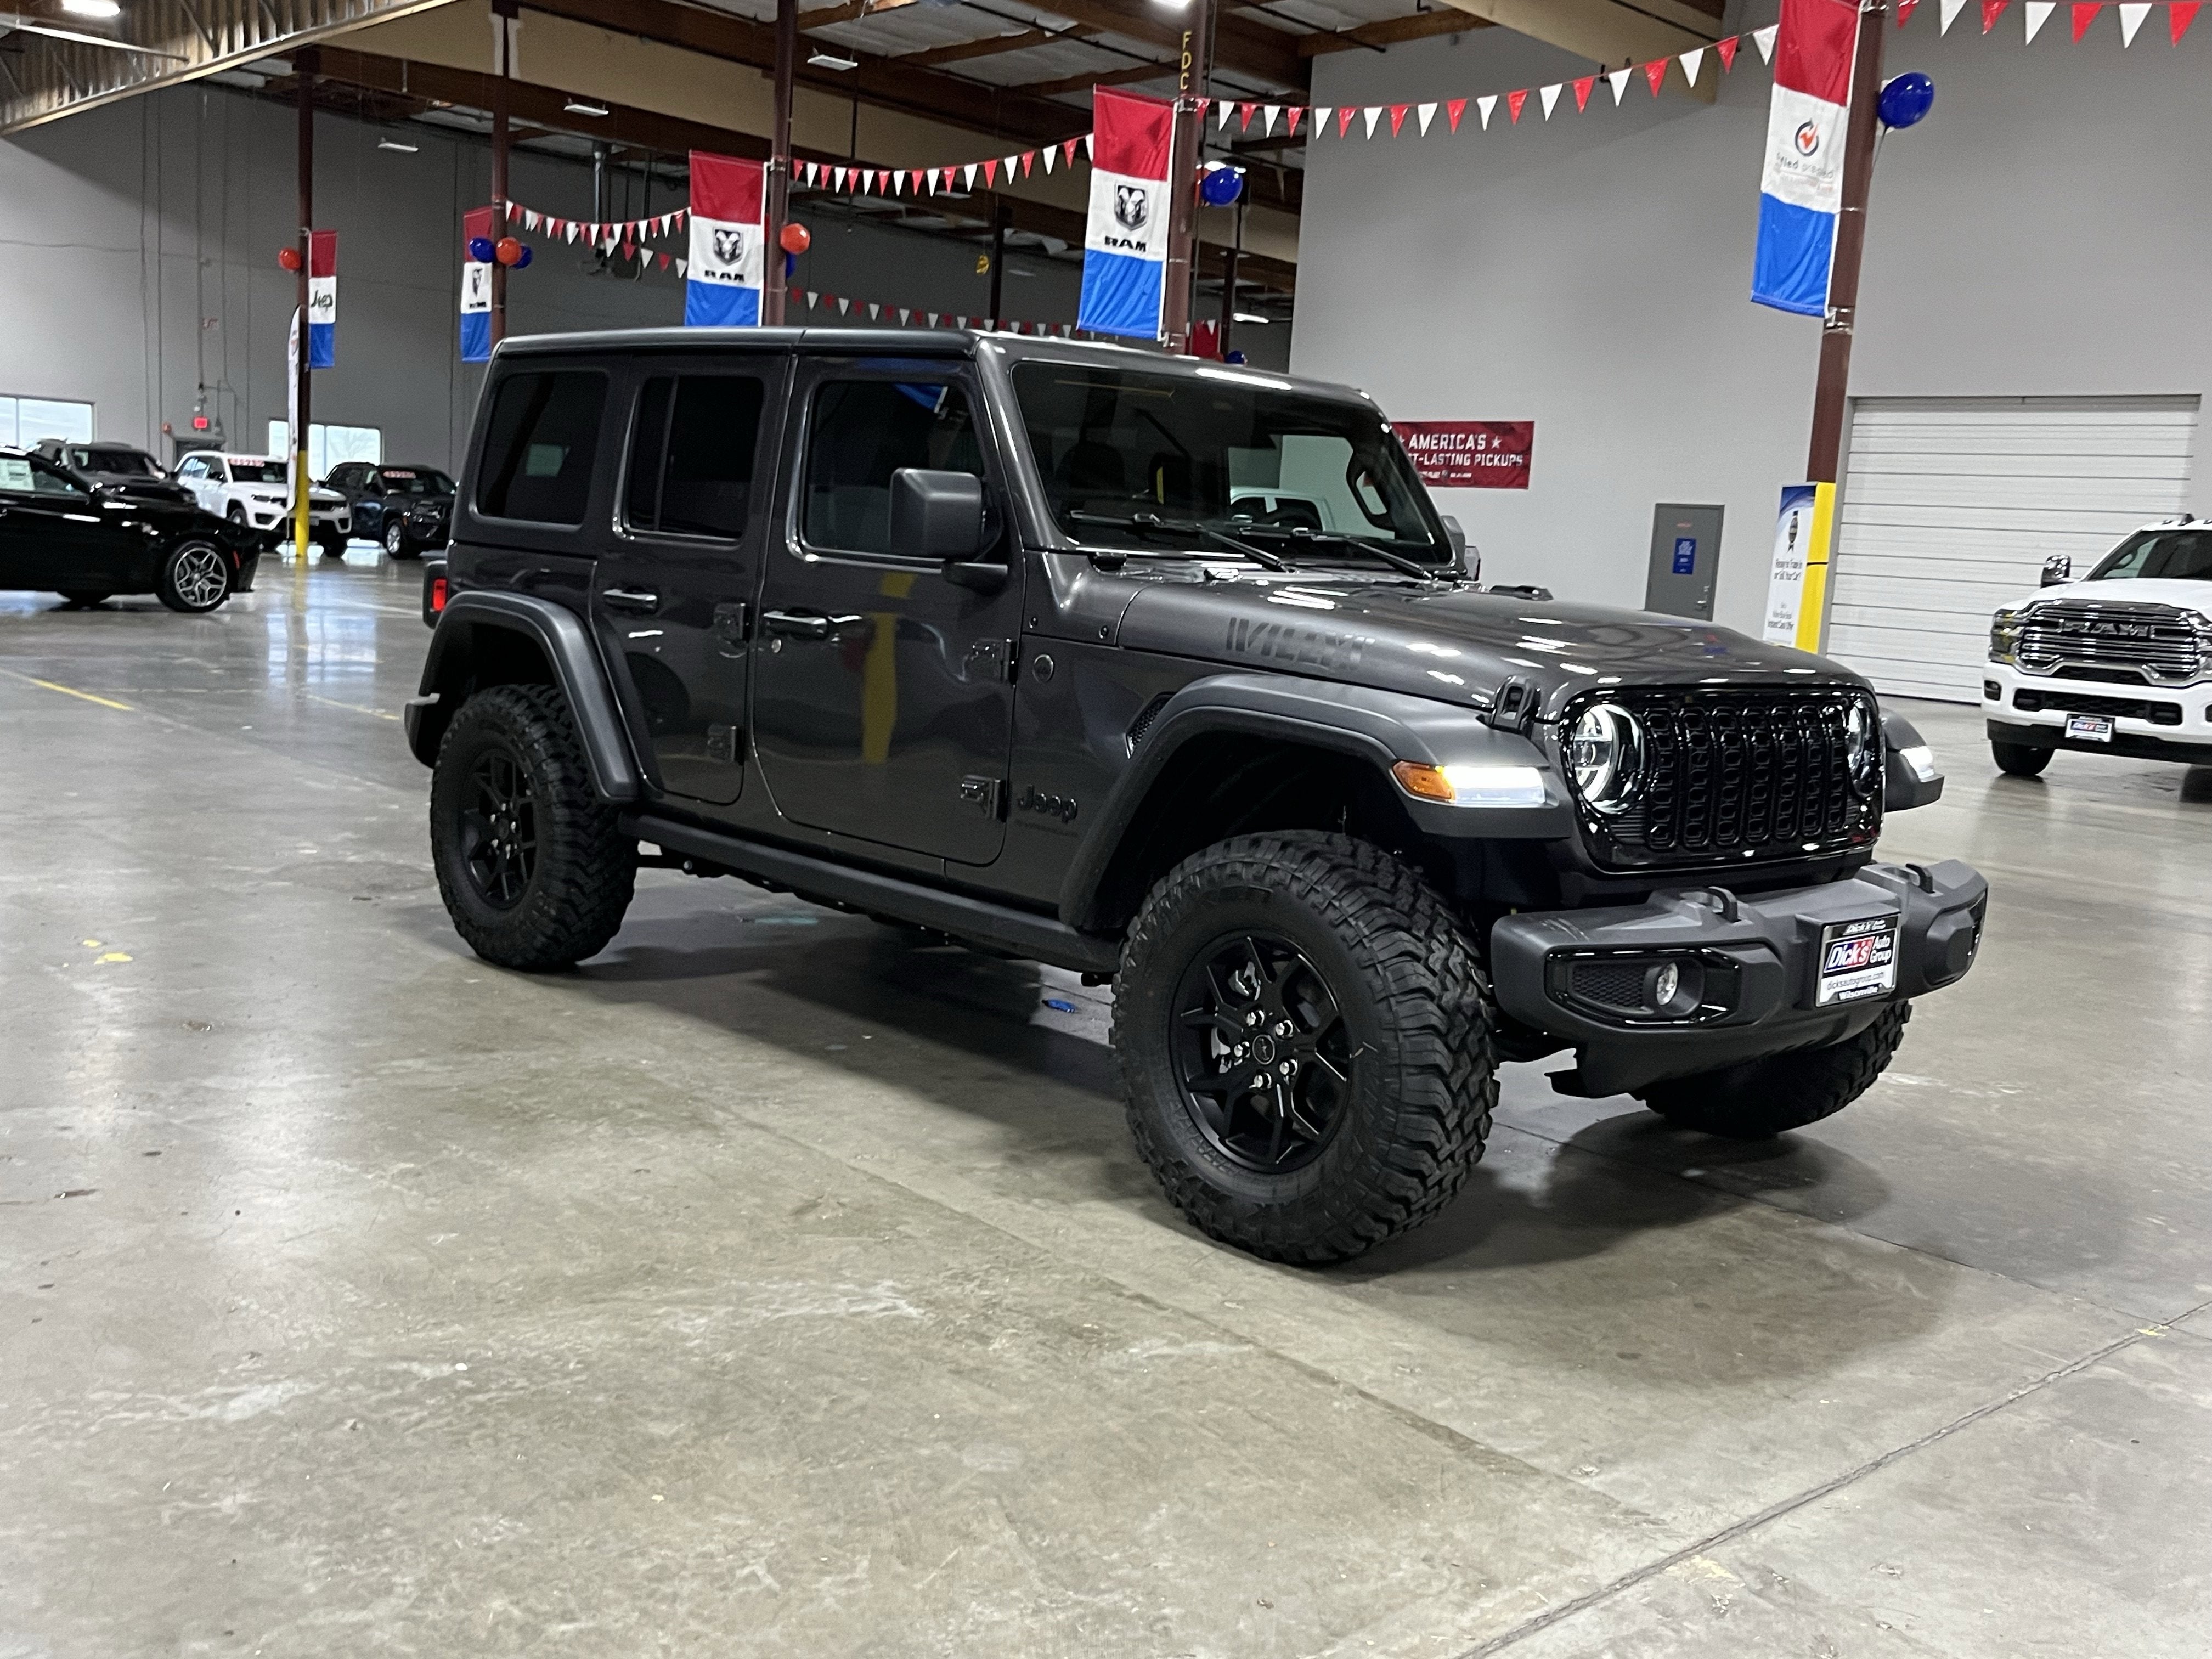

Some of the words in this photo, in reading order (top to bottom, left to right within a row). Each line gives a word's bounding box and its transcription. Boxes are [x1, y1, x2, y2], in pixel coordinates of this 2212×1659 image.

[1180, 31, 1192, 90] FDC
[1104, 235, 1147, 252] RAM
[704, 270, 744, 282] RAM
[1408, 433, 1487, 450] AMERICA'S
[1474, 454, 1523, 467] PICKUPS
[1018, 785, 1077, 825] Jeep
[1827, 940, 1870, 969] Dick's
[1872, 935, 1891, 950] Auto
[1870, 949, 1892, 963] Group
